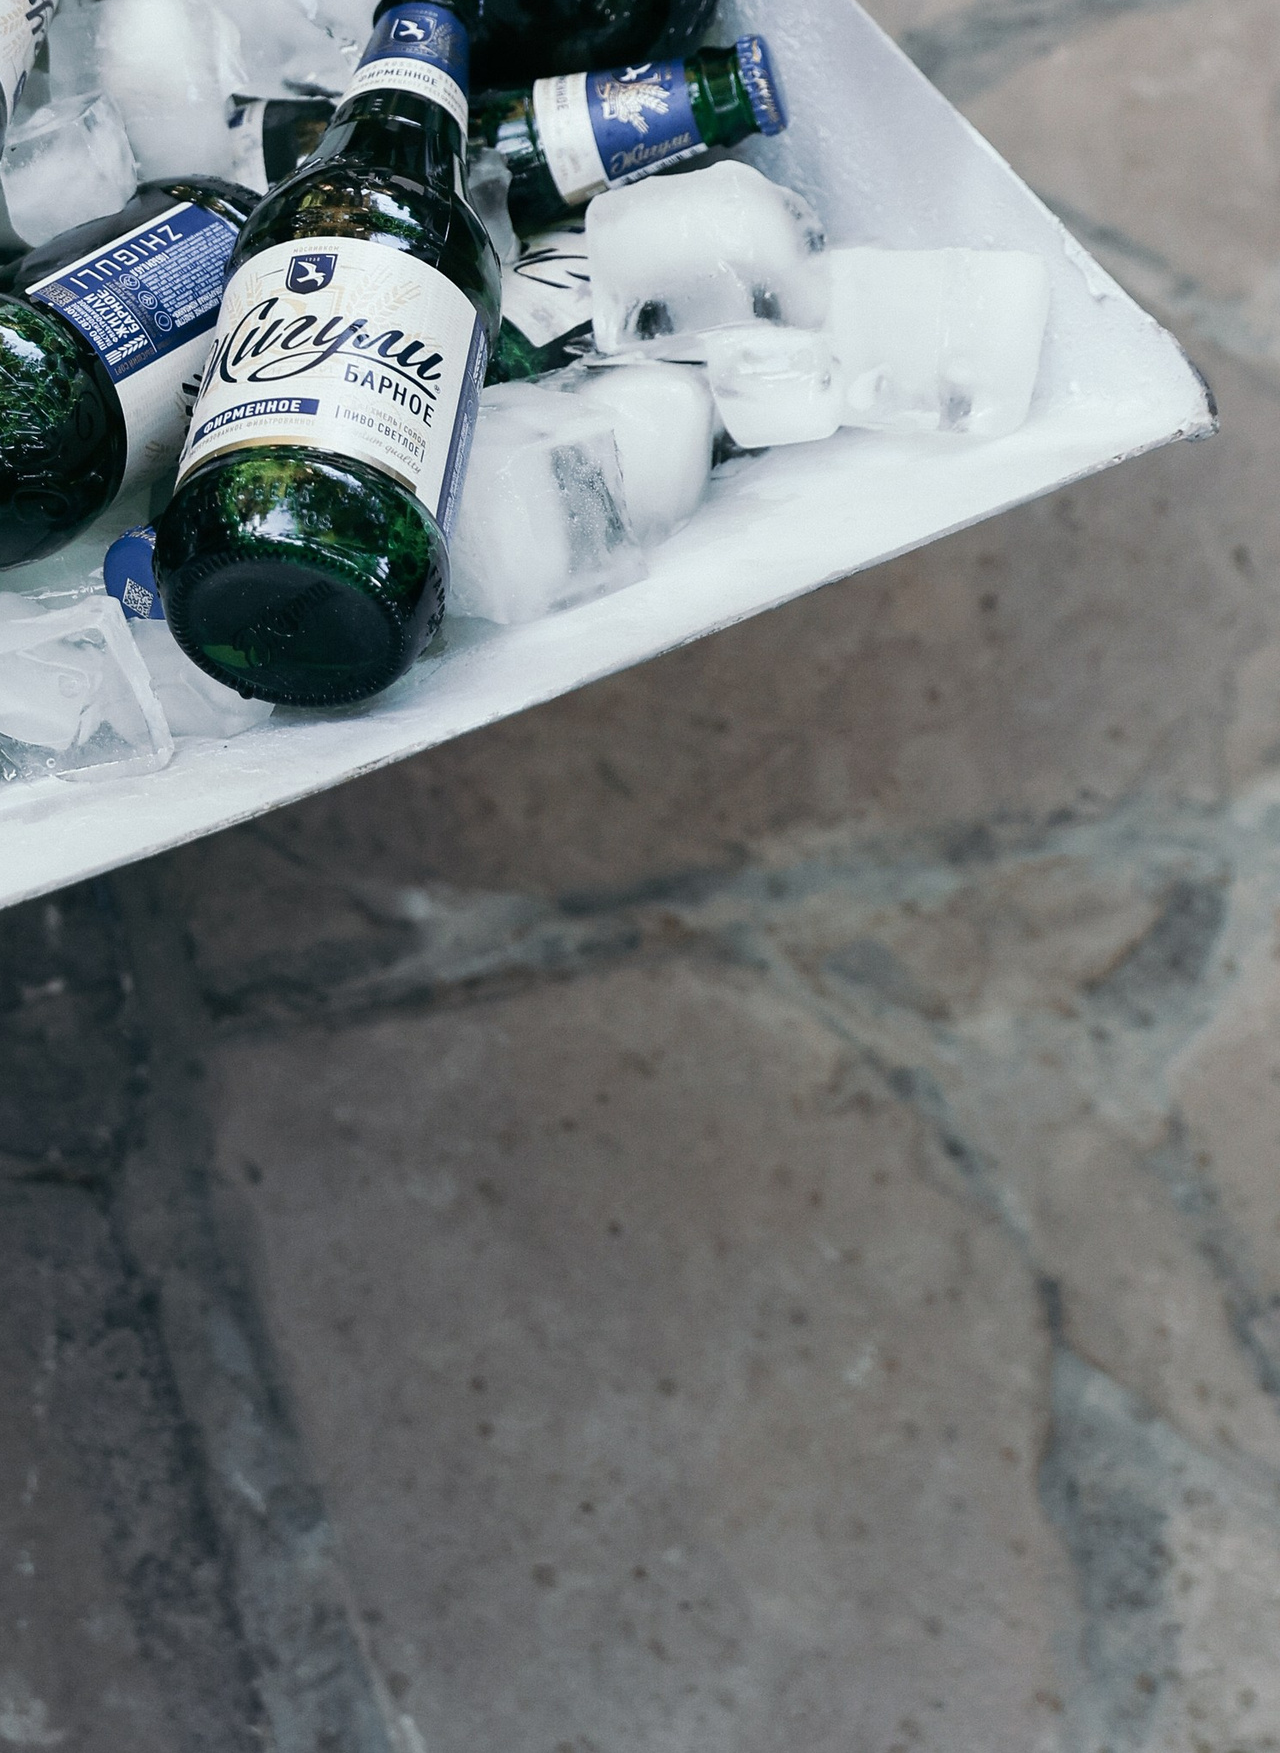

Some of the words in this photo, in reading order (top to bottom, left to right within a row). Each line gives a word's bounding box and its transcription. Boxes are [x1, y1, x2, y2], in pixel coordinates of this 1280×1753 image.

[358, 69, 439, 87] ФИРМЕННОЕ
[610, 132, 692, 174] Жигули
[70, 224, 183, 290] ZHIGULI
[63, 306, 91, 331] СВЕТЛОЕ
[89, 330, 108, 351] ПИВО
[344, 363, 435, 428] БАРНОЕ
[203, 400, 302, 434] ФИРМЕННОЕ
[246, 418, 316, 430] ФИЛЬТРОВАННОЕ
[344, 409, 374, 428] ПИВО
[377, 422, 421, 457] СВЕТЛОЕ
[403, 425, 426, 449] СОЛОД
